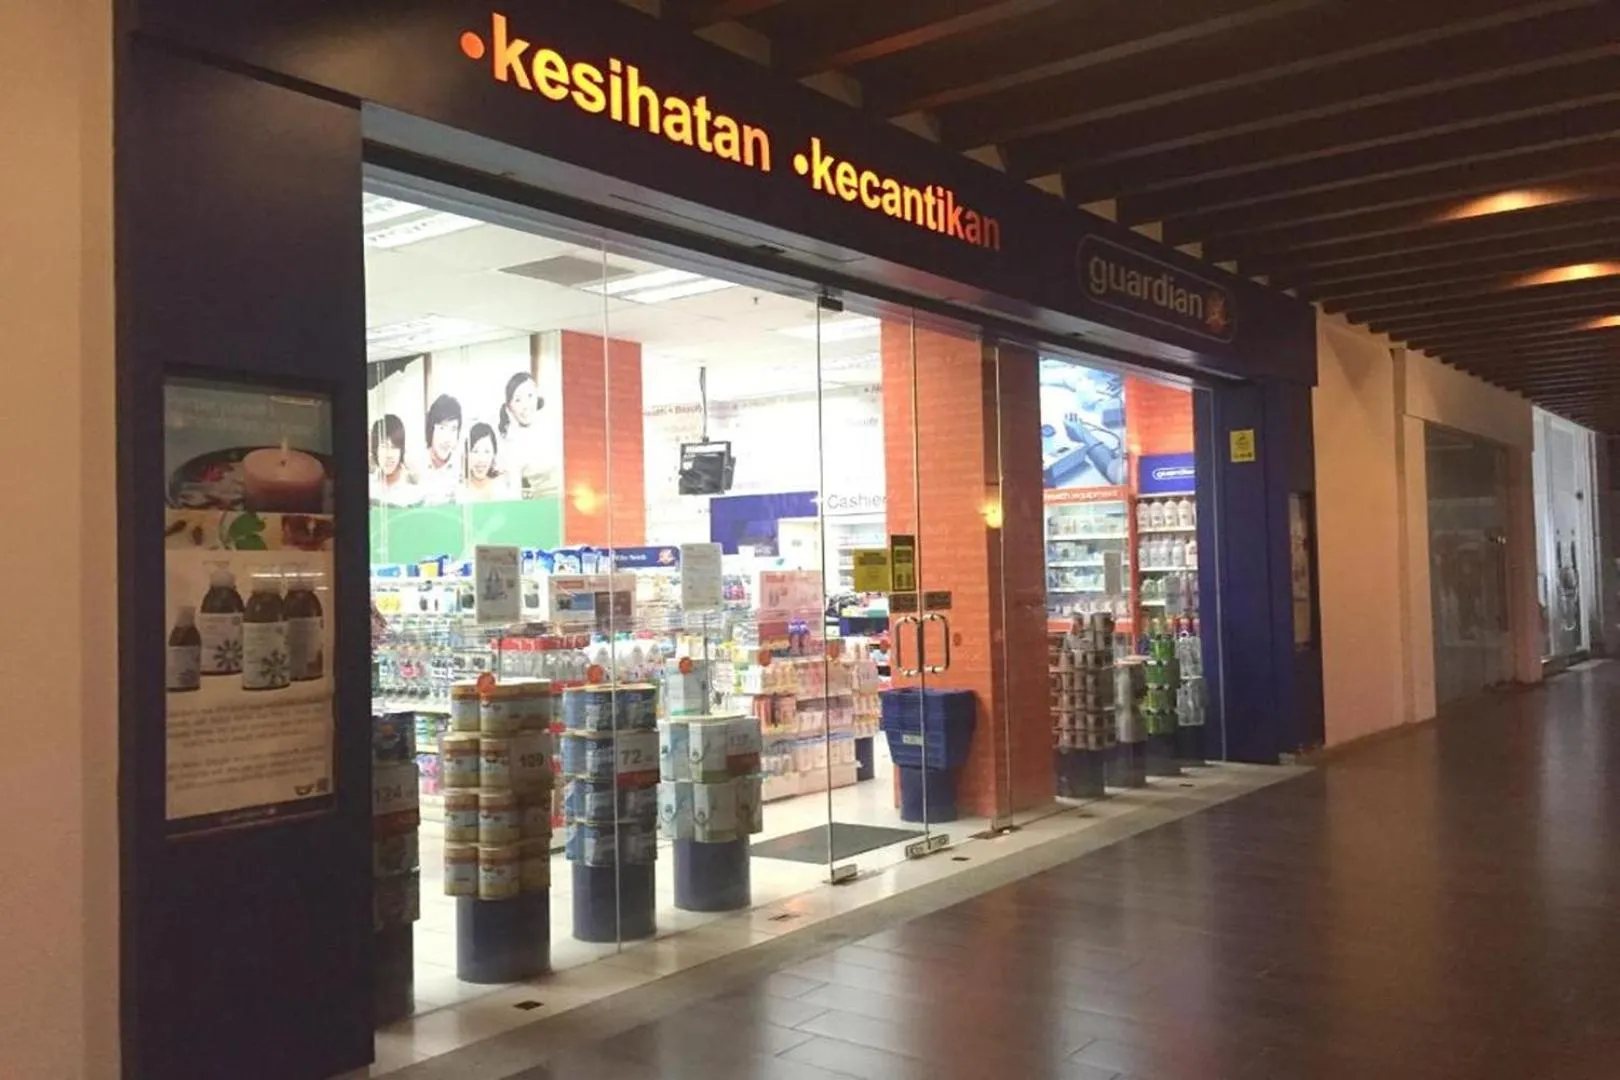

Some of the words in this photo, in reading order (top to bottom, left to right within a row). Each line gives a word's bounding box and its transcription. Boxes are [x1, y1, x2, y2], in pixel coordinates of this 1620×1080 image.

[491, 12, 771, 172] kesihatan
[811, 137, 1001, 252] kecantikan
[1088, 254, 1204, 319] guardian
[619, 748, 643, 766] 72
